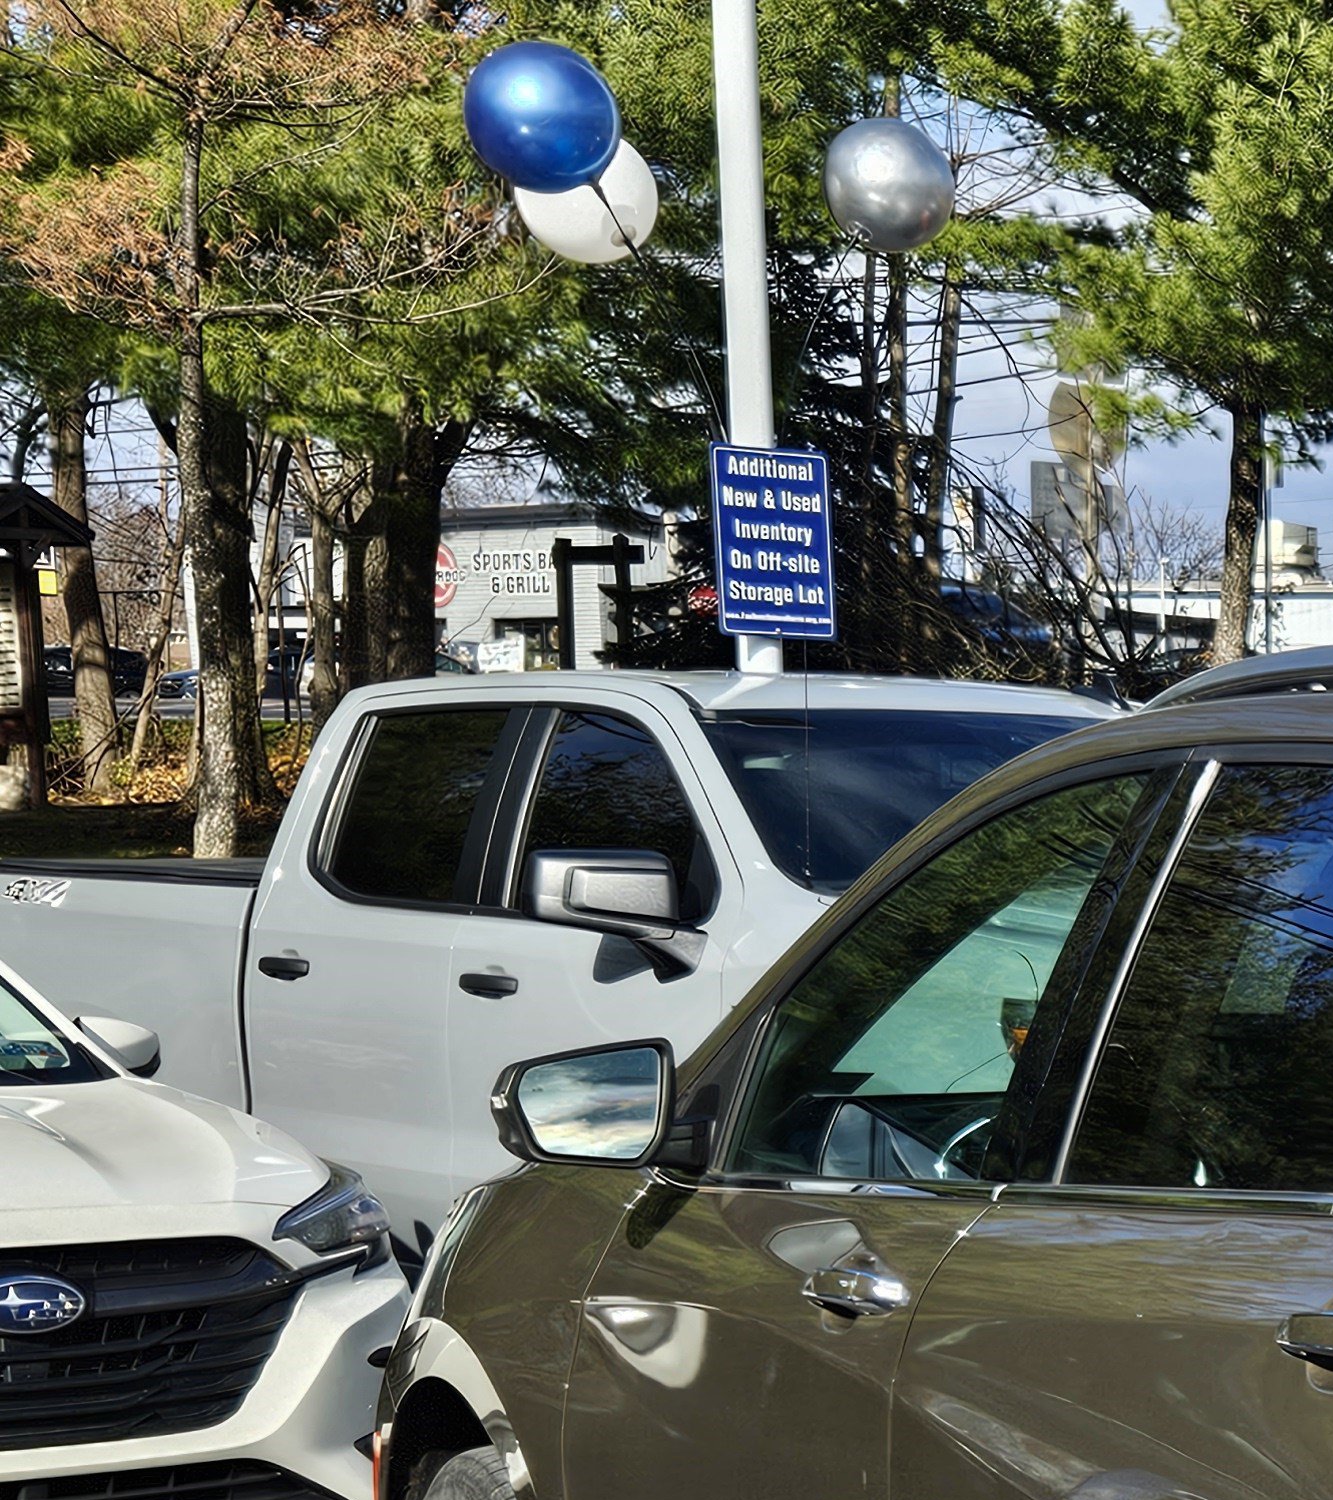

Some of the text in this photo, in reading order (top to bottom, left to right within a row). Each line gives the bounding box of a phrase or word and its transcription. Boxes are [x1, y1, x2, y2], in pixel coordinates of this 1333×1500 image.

[727, 455, 814, 482] Additional
[722, 485, 822, 514] New & Used
[734, 517, 813, 547] Inventory
[472, 552, 532, 572] SPORTS
[730, 548, 820, 574] On Off-site
[491, 575, 551, 594] & GRILL
[729, 579, 794, 607] Storage
[798, 583, 825, 606] Lot
